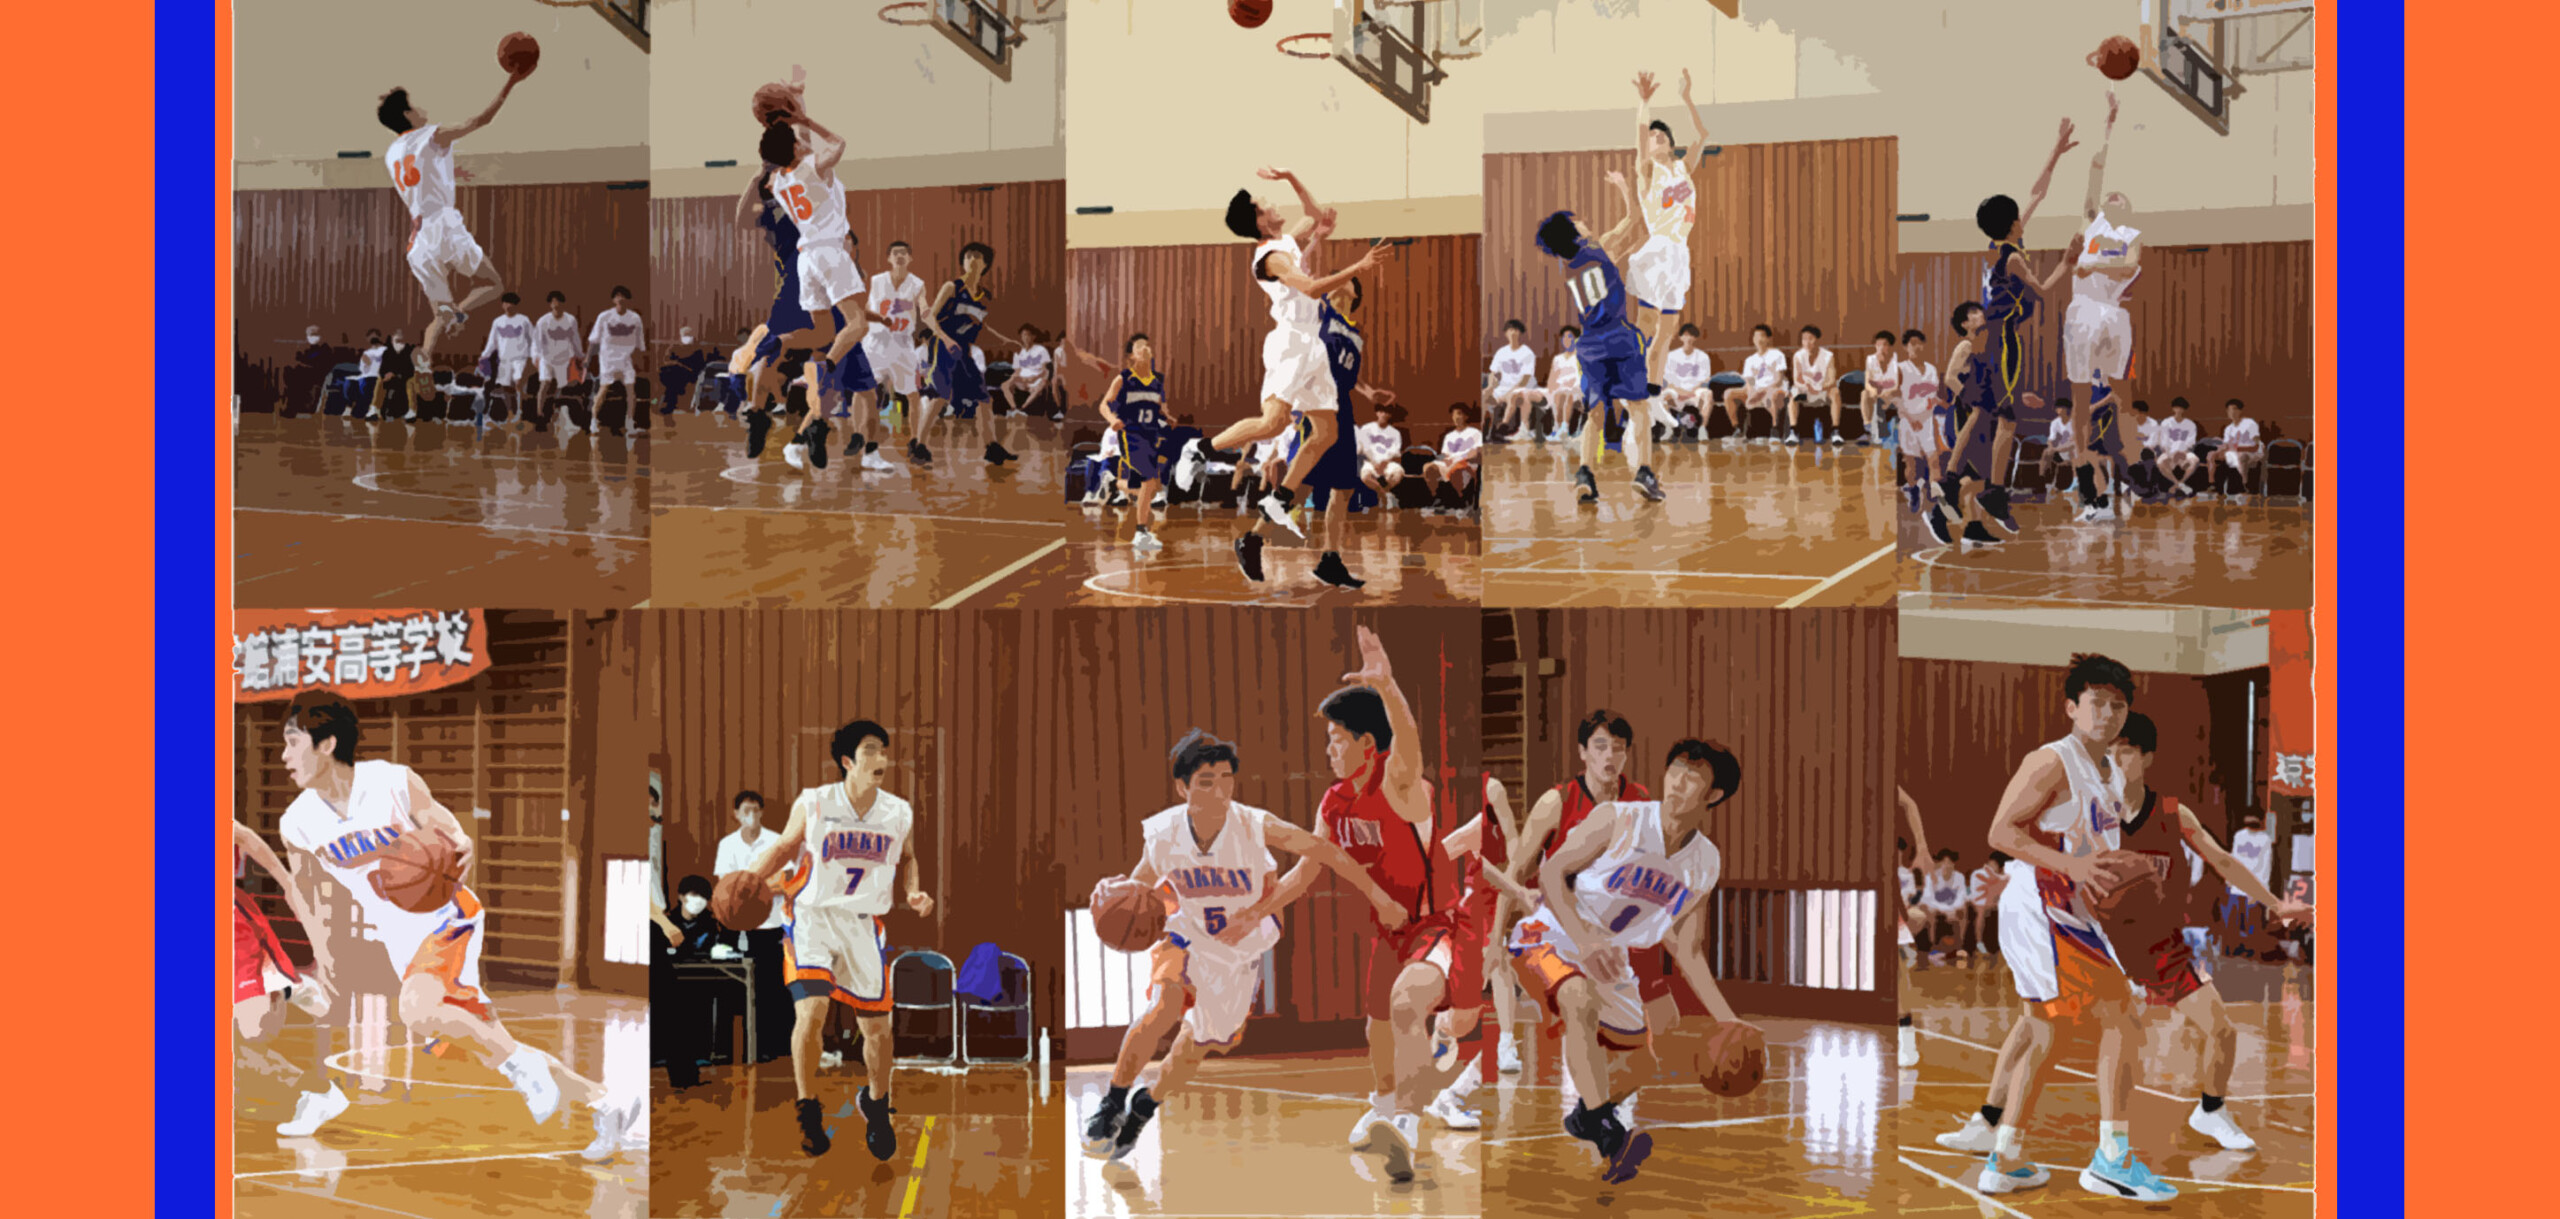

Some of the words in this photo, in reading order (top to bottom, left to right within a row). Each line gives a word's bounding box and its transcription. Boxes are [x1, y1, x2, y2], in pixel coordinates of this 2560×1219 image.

[779, 184, 813, 224] 15
[1567, 266, 1608, 315] 10
[844, 867, 865, 896] 7
[1203, 906, 1227, 936] 5
